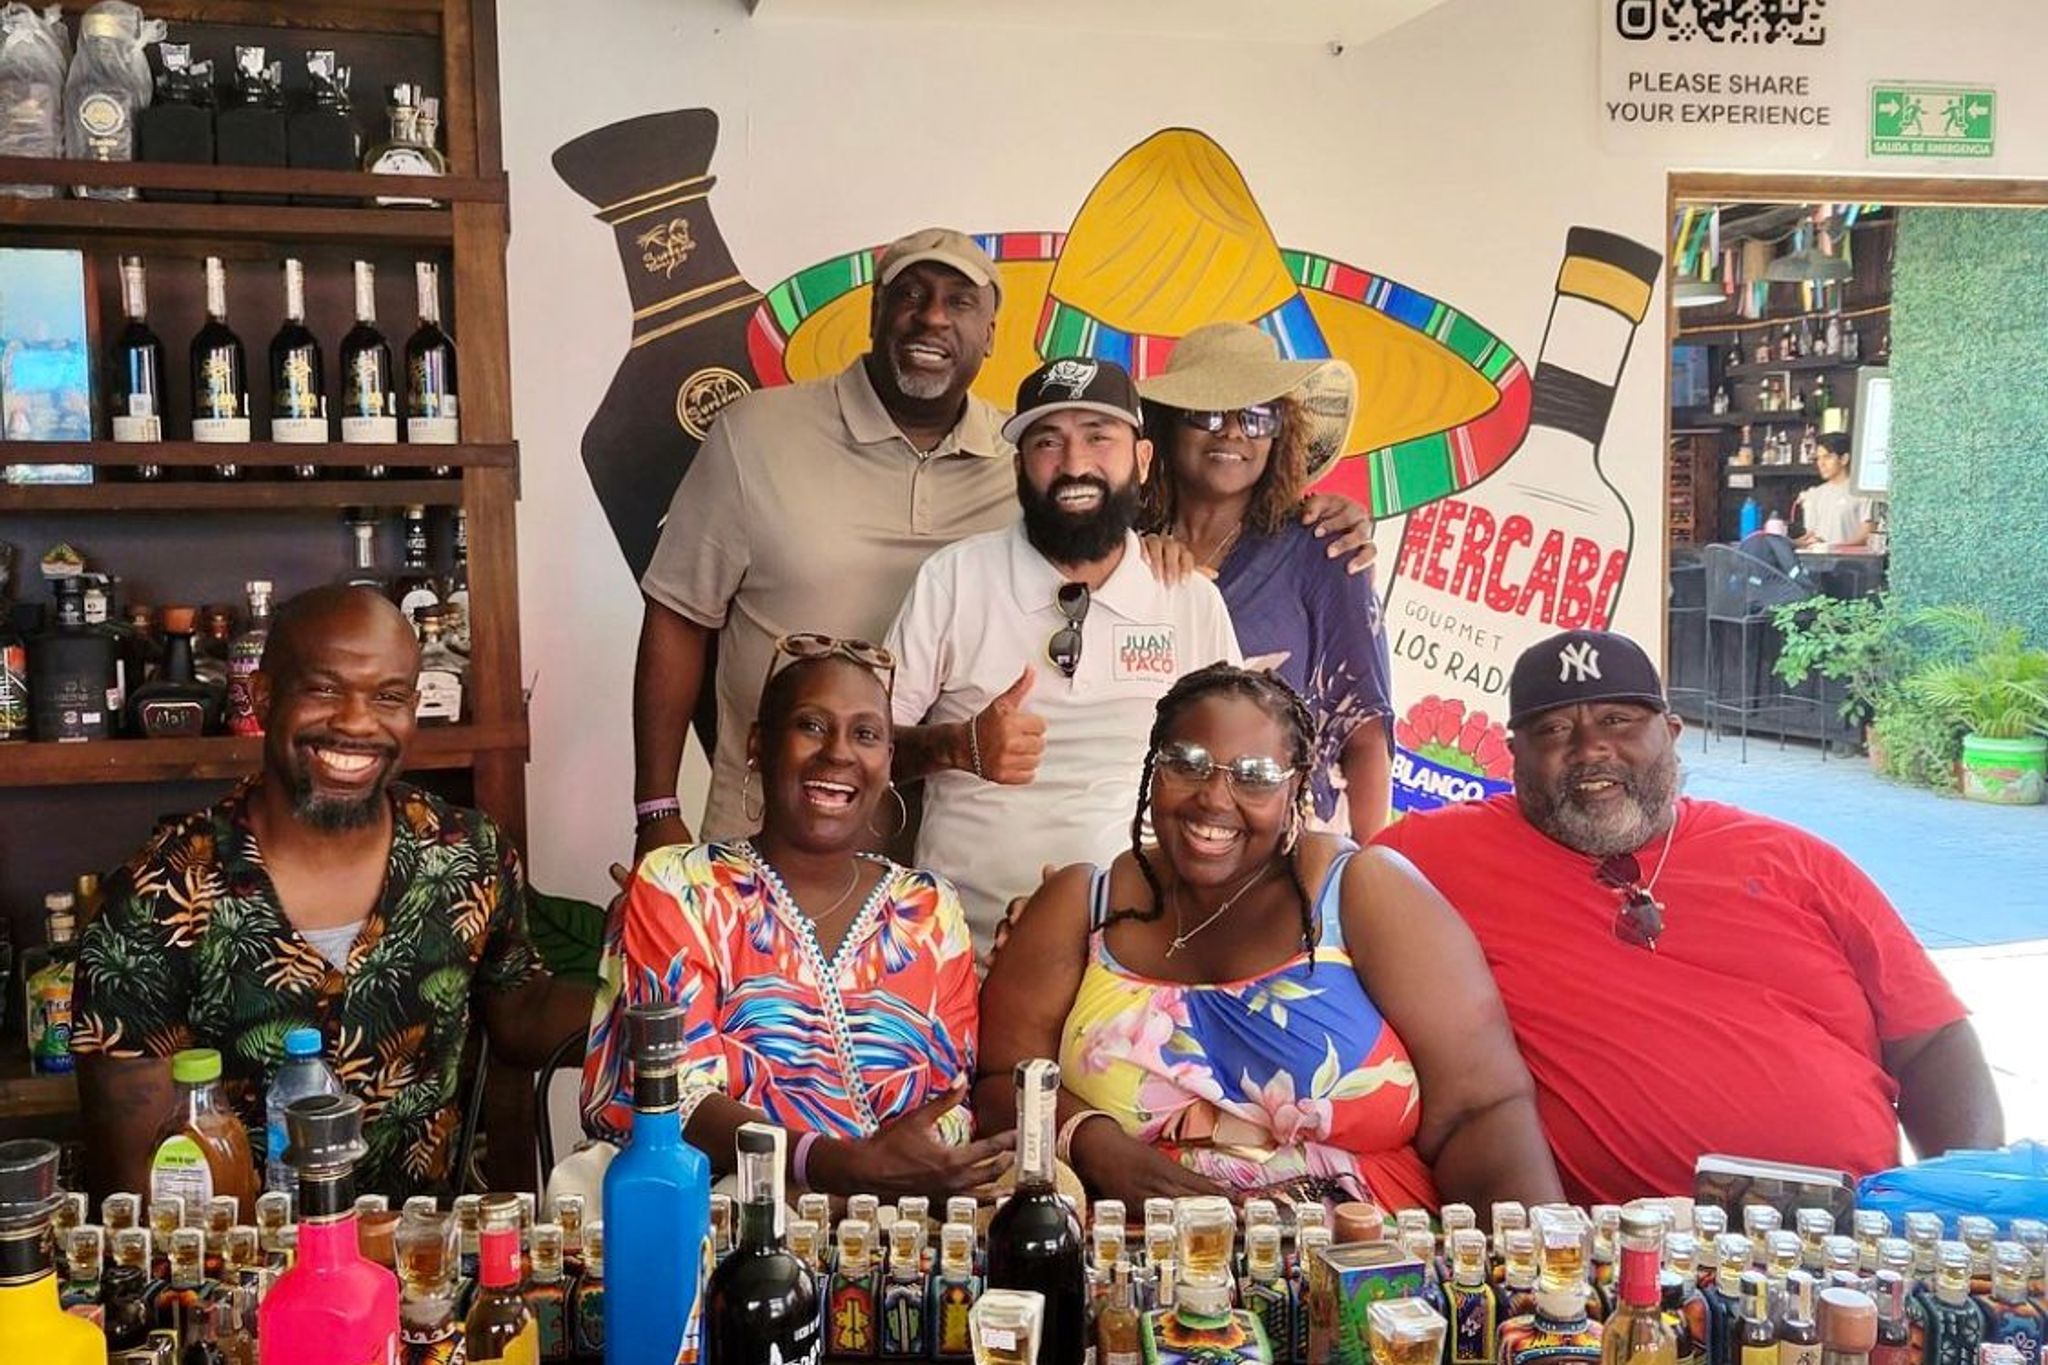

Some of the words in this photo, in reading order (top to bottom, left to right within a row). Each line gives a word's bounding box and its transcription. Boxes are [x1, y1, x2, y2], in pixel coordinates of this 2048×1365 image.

[1628, 72, 1721, 93] PLEASE
[1728, 74, 1809, 96] SHARE
[1606, 102, 1675, 123] YOUR
[1681, 104, 1830, 126] EXPERIENCE
[1121, 631, 1172, 650] JUAN
[1404, 600, 1503, 652] GOURMET
[1125, 657, 1174, 674] TACO
[1393, 628, 1441, 670] LOS
[1558, 640, 1602, 683] NY
[1391, 753, 1485, 802] BLANCO
